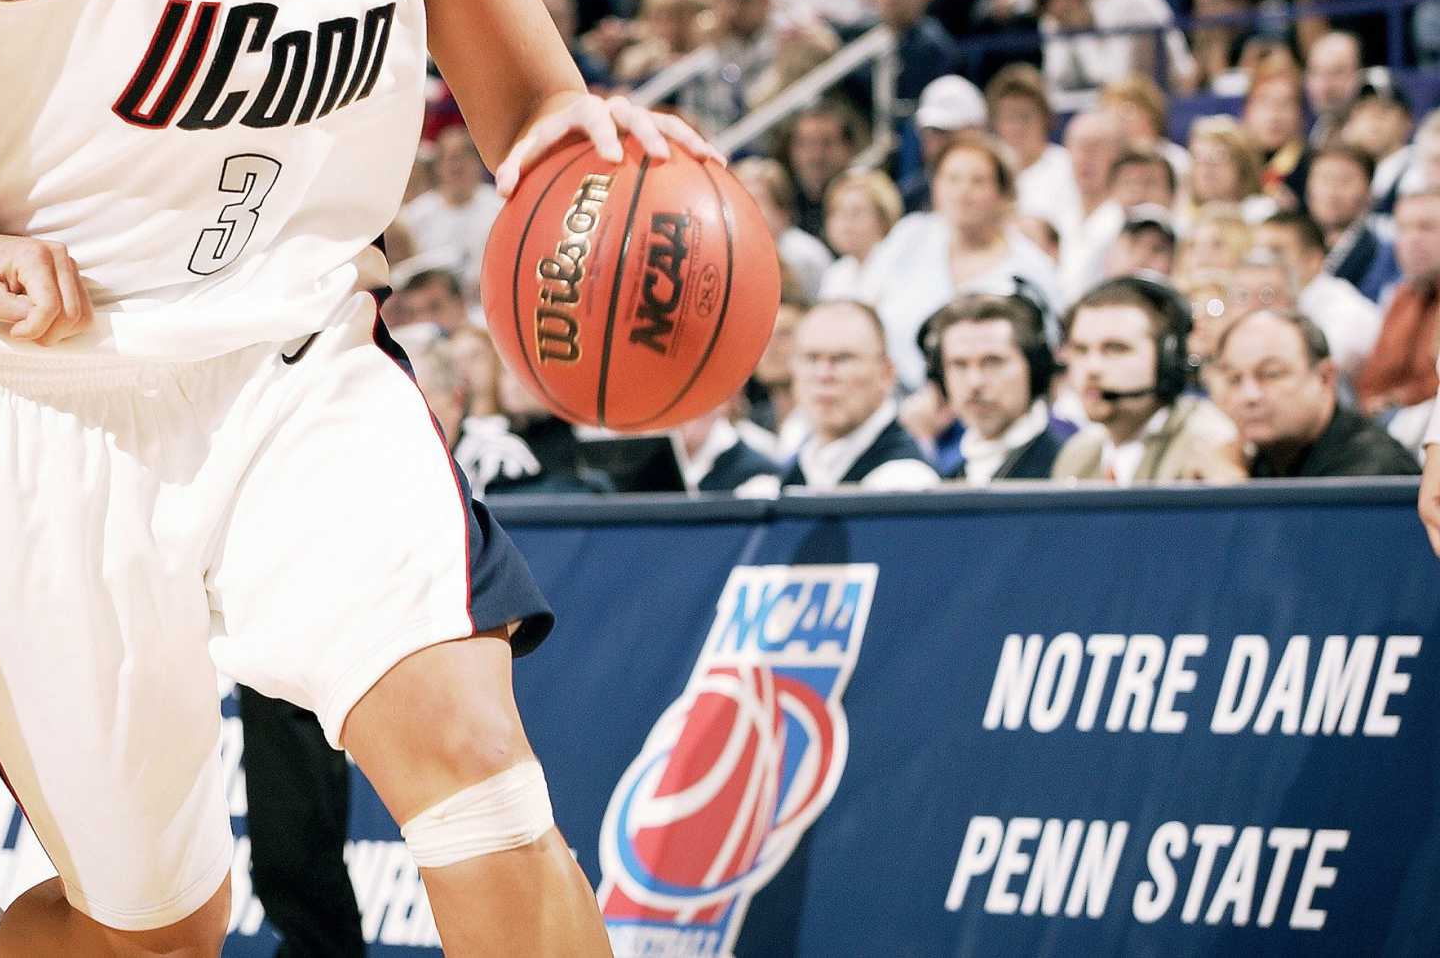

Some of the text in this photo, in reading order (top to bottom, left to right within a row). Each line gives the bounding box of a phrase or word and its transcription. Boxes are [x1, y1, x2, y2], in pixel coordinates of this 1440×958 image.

[188, 153, 283, 276] 3
[534, 172, 617, 366] Wilson
[629, 210, 691, 356] NCAA
[716, 581, 866, 654] NCAA
[982, 632, 1423, 737] NOTRE DAME
[944, 816, 1351, 931] PENN STATE
